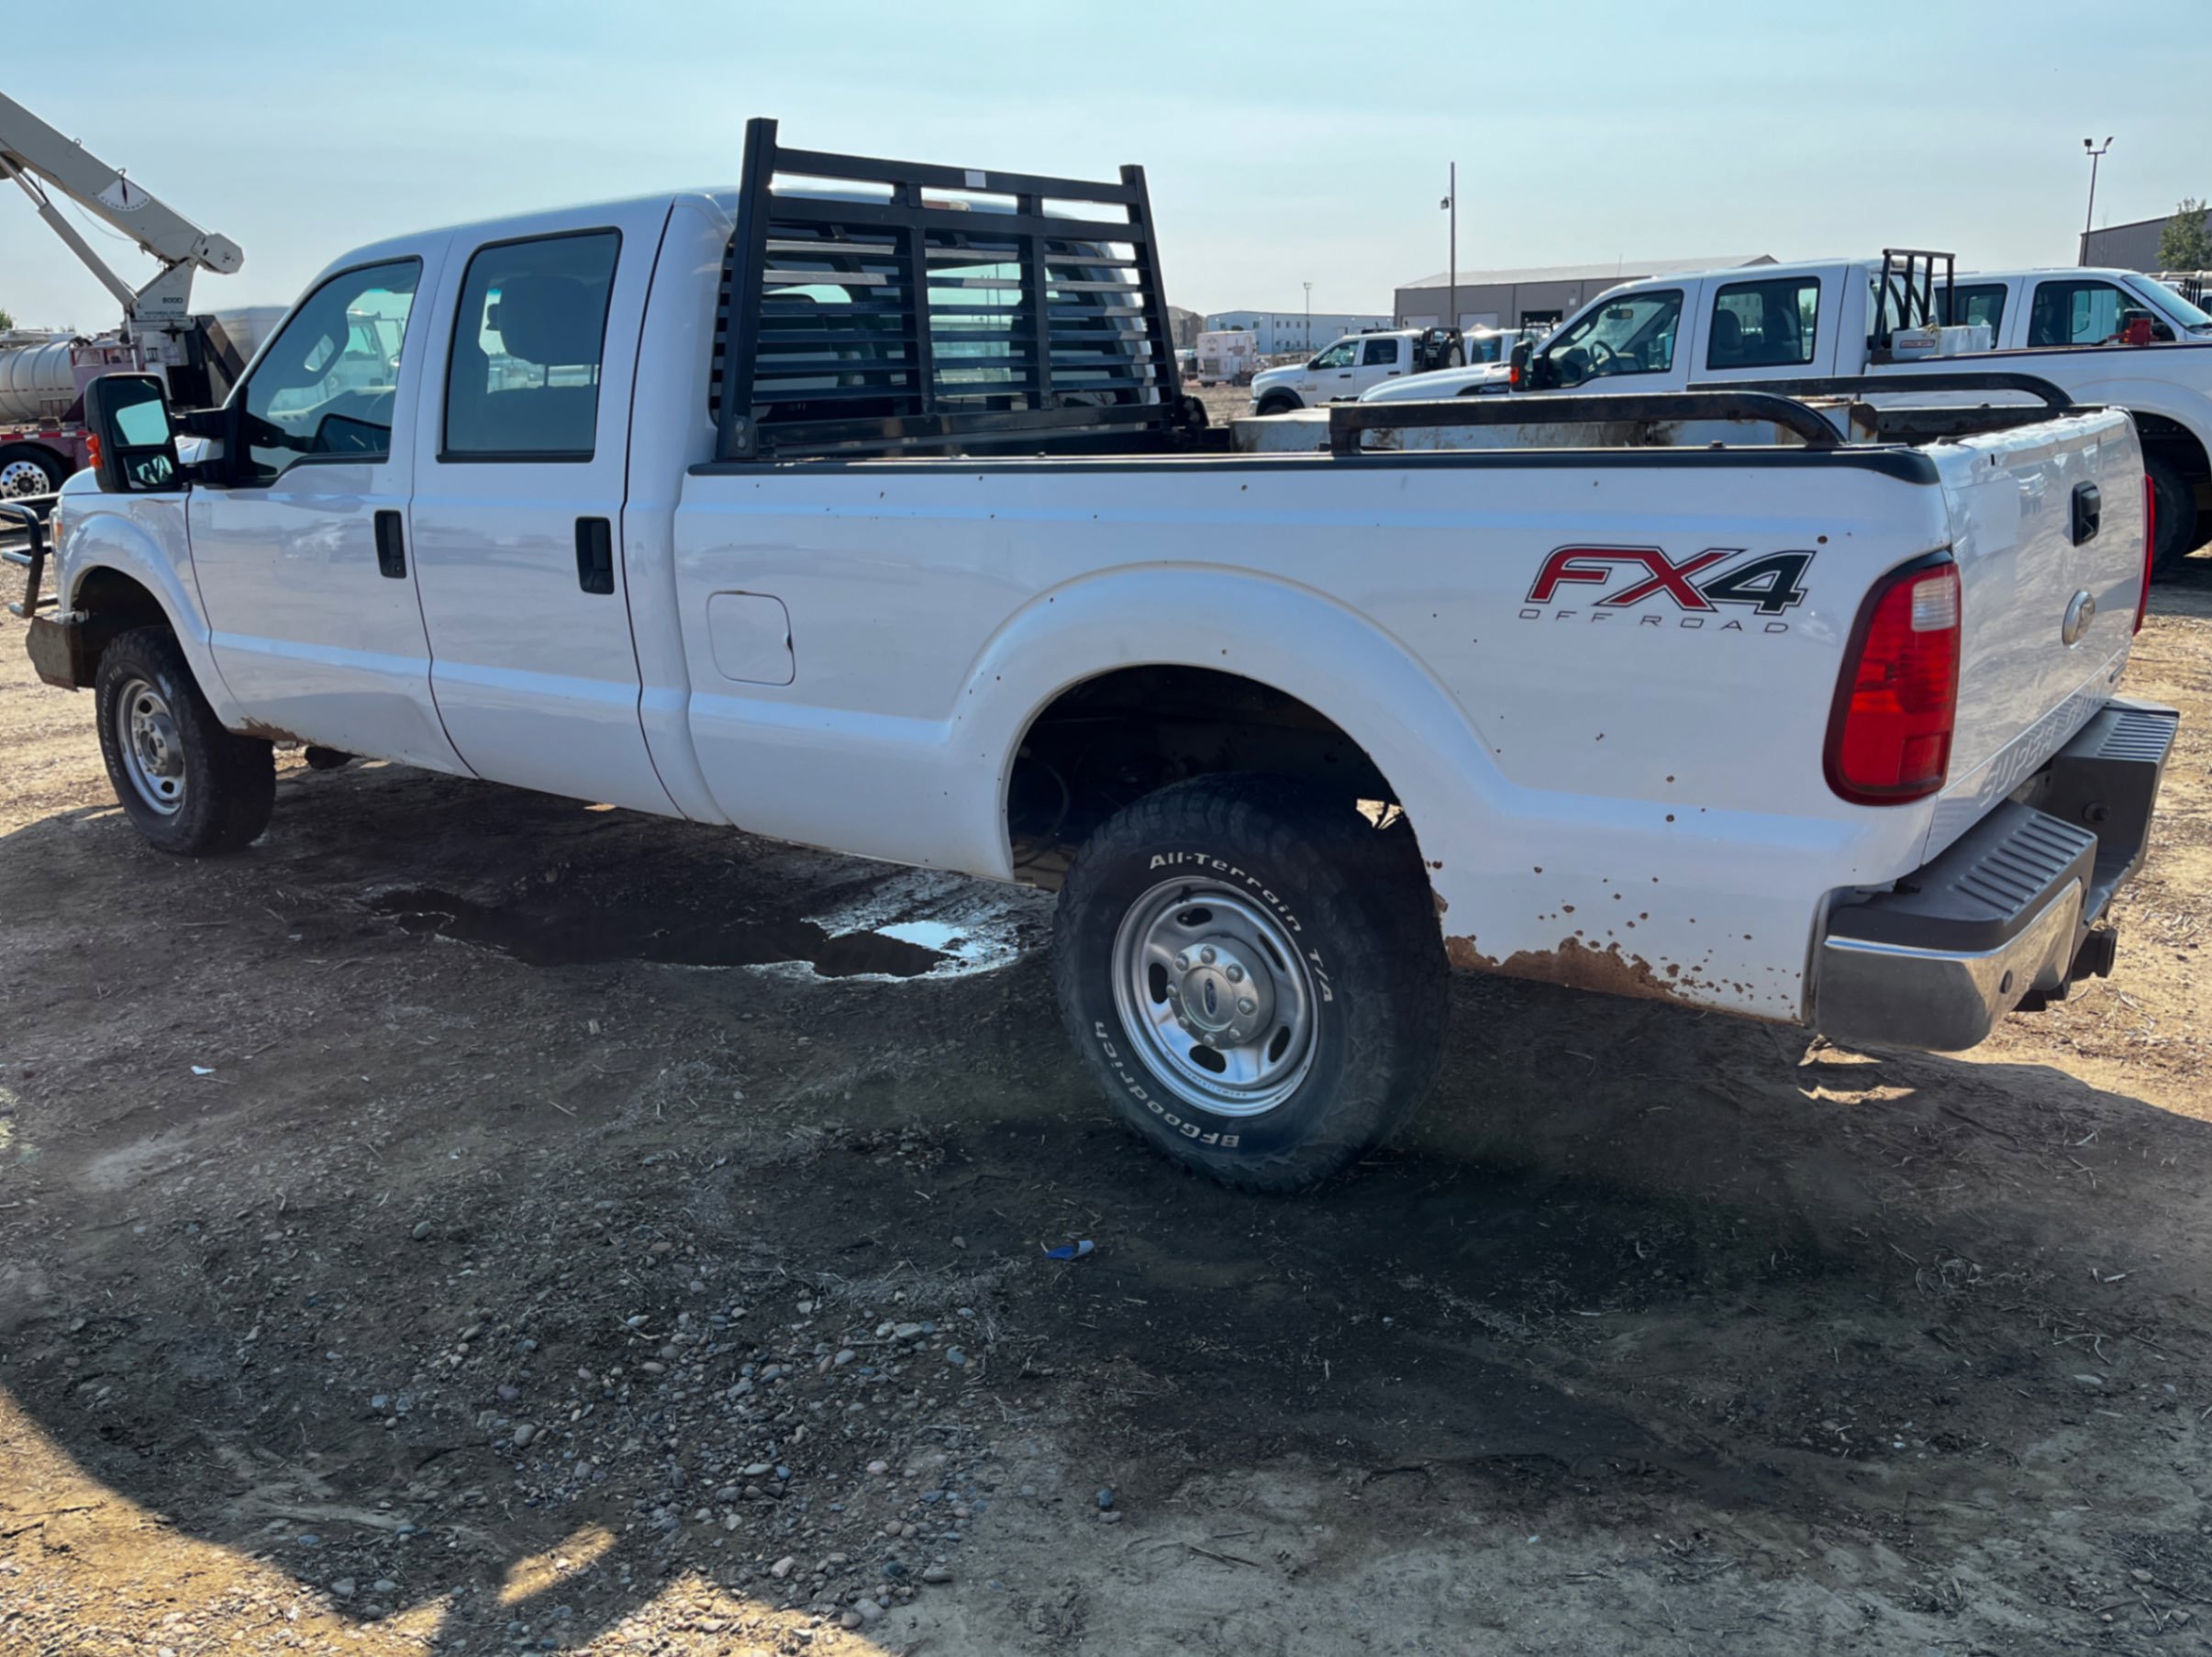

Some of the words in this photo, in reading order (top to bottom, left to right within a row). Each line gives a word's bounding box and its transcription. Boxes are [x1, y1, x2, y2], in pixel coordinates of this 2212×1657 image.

[1518, 608, 1614, 623] OFF
[1639, 615, 1790, 633] ROAD
[1525, 543, 1817, 616] FX4
[1978, 717, 2059, 808] SUPER
[1149, 851, 1302, 932] All-Terrain
[1307, 948, 1334, 1003] T/A
[1095, 1020, 1240, 1148] BFGoodrich
